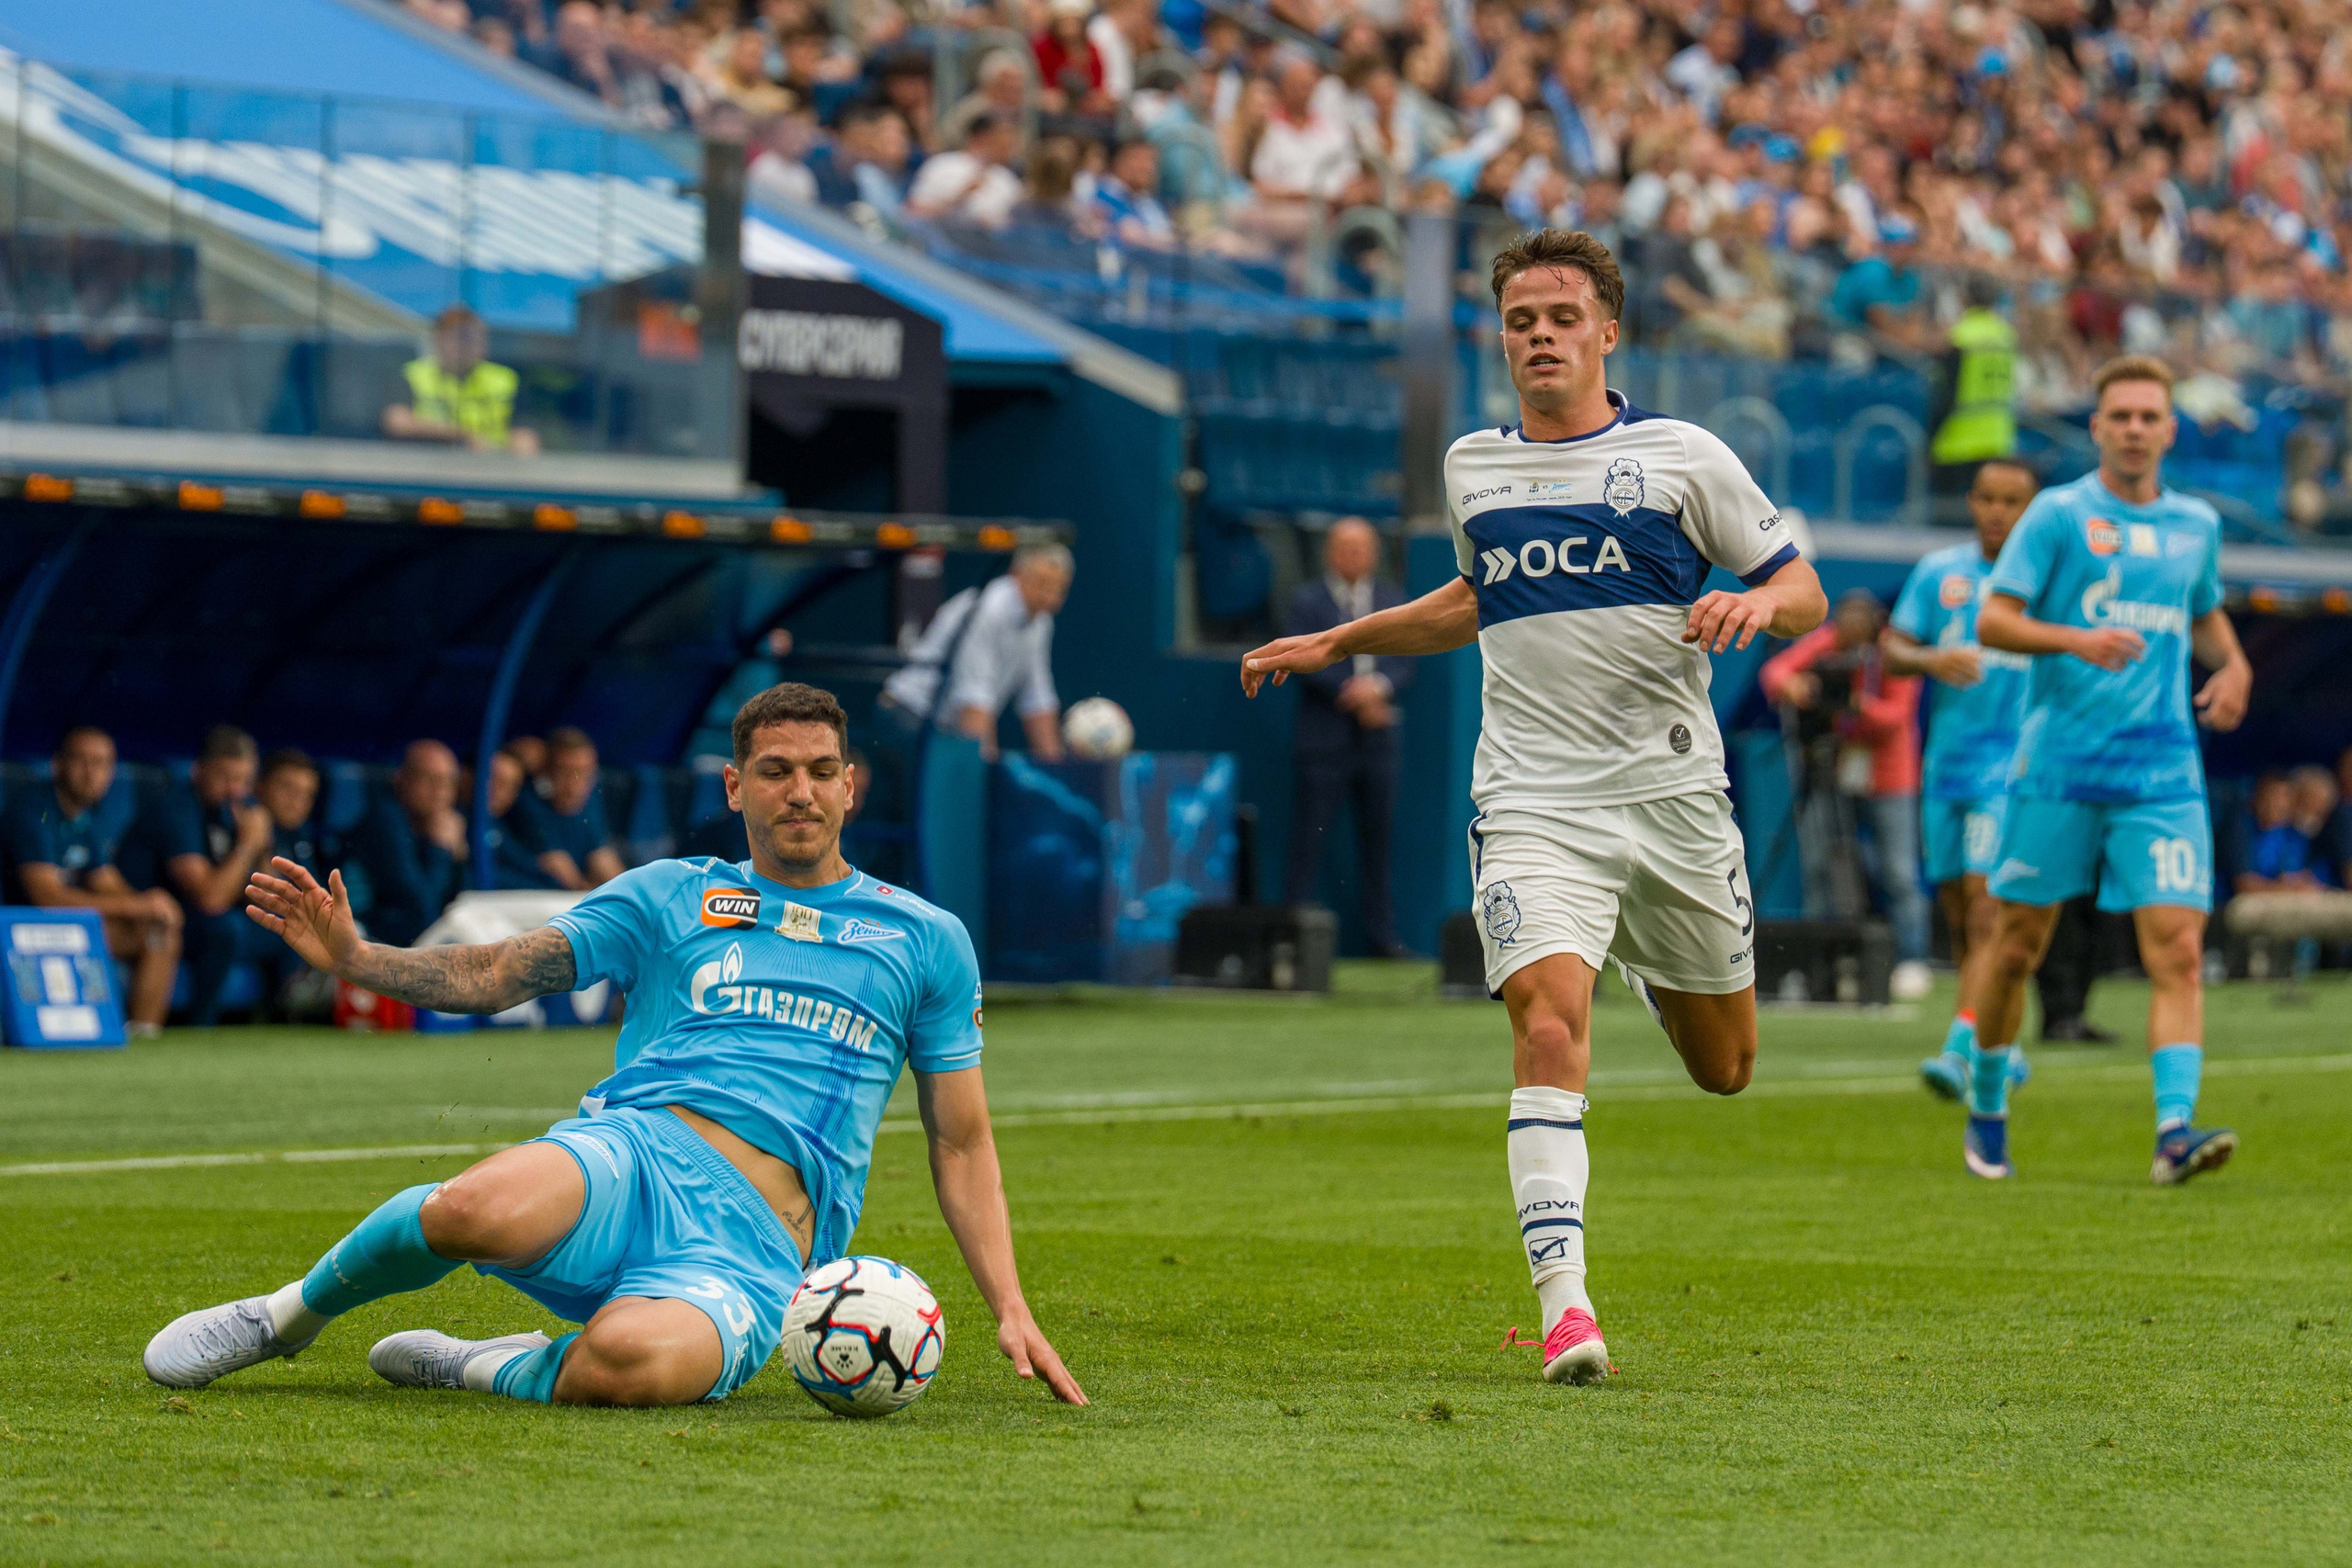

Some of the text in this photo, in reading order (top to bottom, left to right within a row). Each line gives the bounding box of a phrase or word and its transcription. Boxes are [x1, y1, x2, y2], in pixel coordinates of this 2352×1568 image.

[1462, 486, 1511, 505] GIVOVA
[1519, 536, 1632, 578] OCA
[2149, 837, 2195, 893] 10
[715, 899, 755, 915] WIN
[1727, 867, 1753, 936] 5
[743, 986, 877, 1053] ГАЗПРОМ
[685, 1275, 756, 1337] 33
